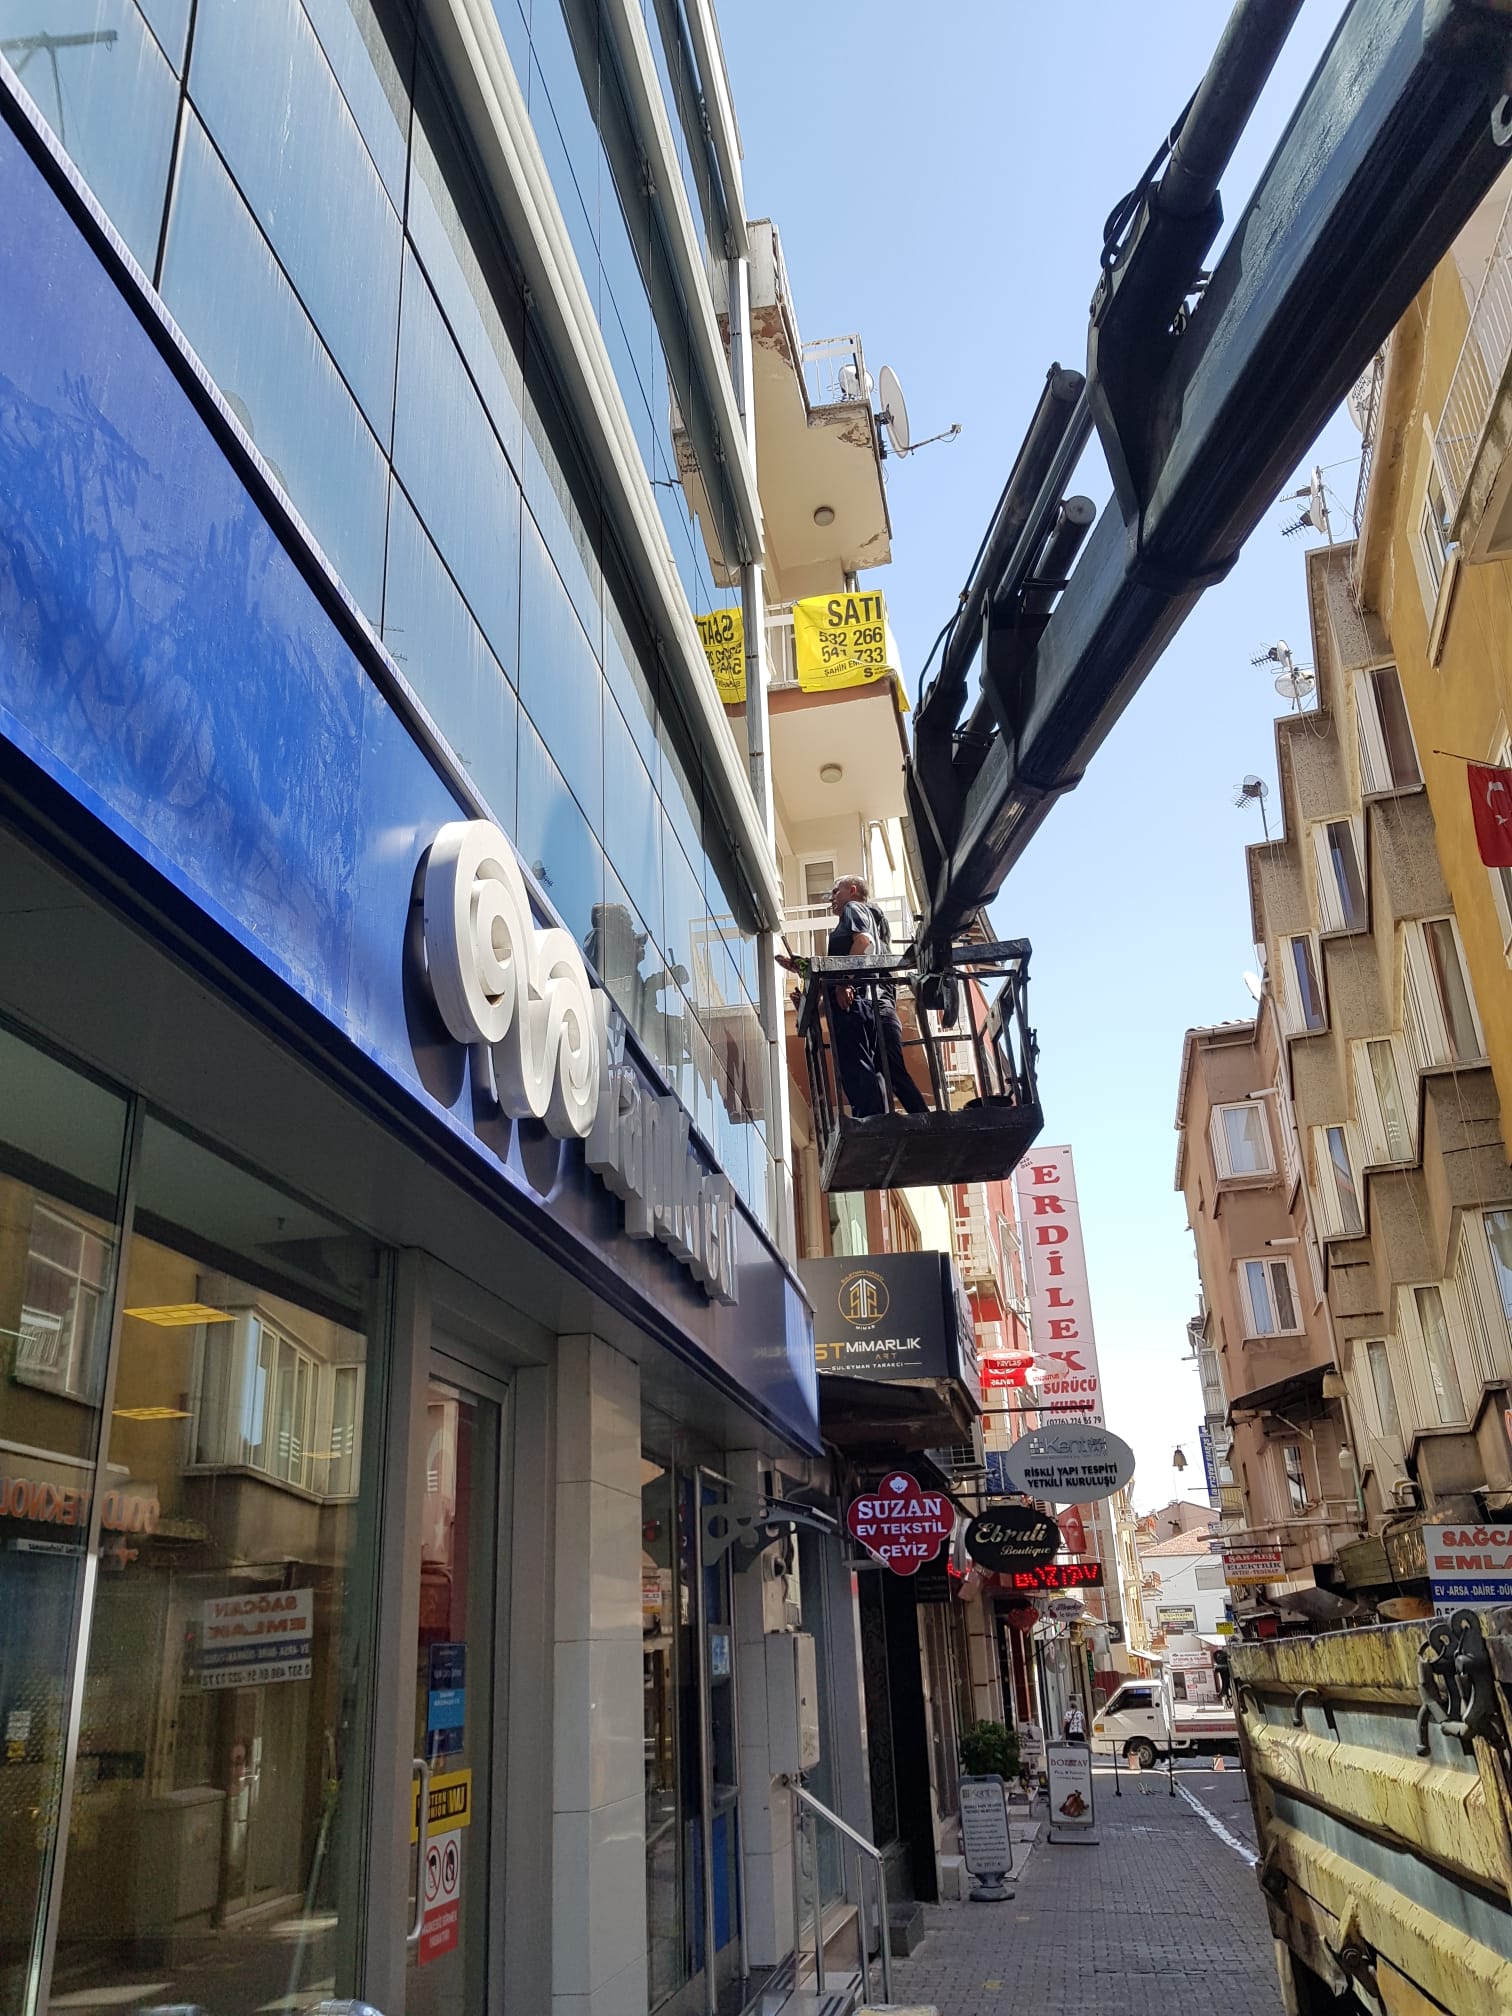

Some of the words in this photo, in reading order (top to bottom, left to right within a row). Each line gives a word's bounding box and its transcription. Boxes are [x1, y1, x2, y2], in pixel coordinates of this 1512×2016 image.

[853, 626, 883, 647] 266
[1030, 1164, 1086, 1371] ERDİLEK
[1024, 1467, 1054, 1478] RİSKLİ
[1057, 1465, 1078, 1477] YAPI
[1082, 1463, 1118, 1475] TESPİTİ
[1027, 1476, 1063, 1488] YETKİLİ
[1066, 1475, 1117, 1488] KURULUŞU
[858, 1497, 942, 1519] SUZAN
[857, 1523, 876, 1536] EV
[881, 1518, 948, 1535] TEKSTİL
[974, 1521, 1048, 1543] Ebruli
[879, 1542, 928, 1560] ÇEYİZ
[1000, 1544, 1051, 1558] Boutique
[1434, 1585, 1445, 1596] EV
